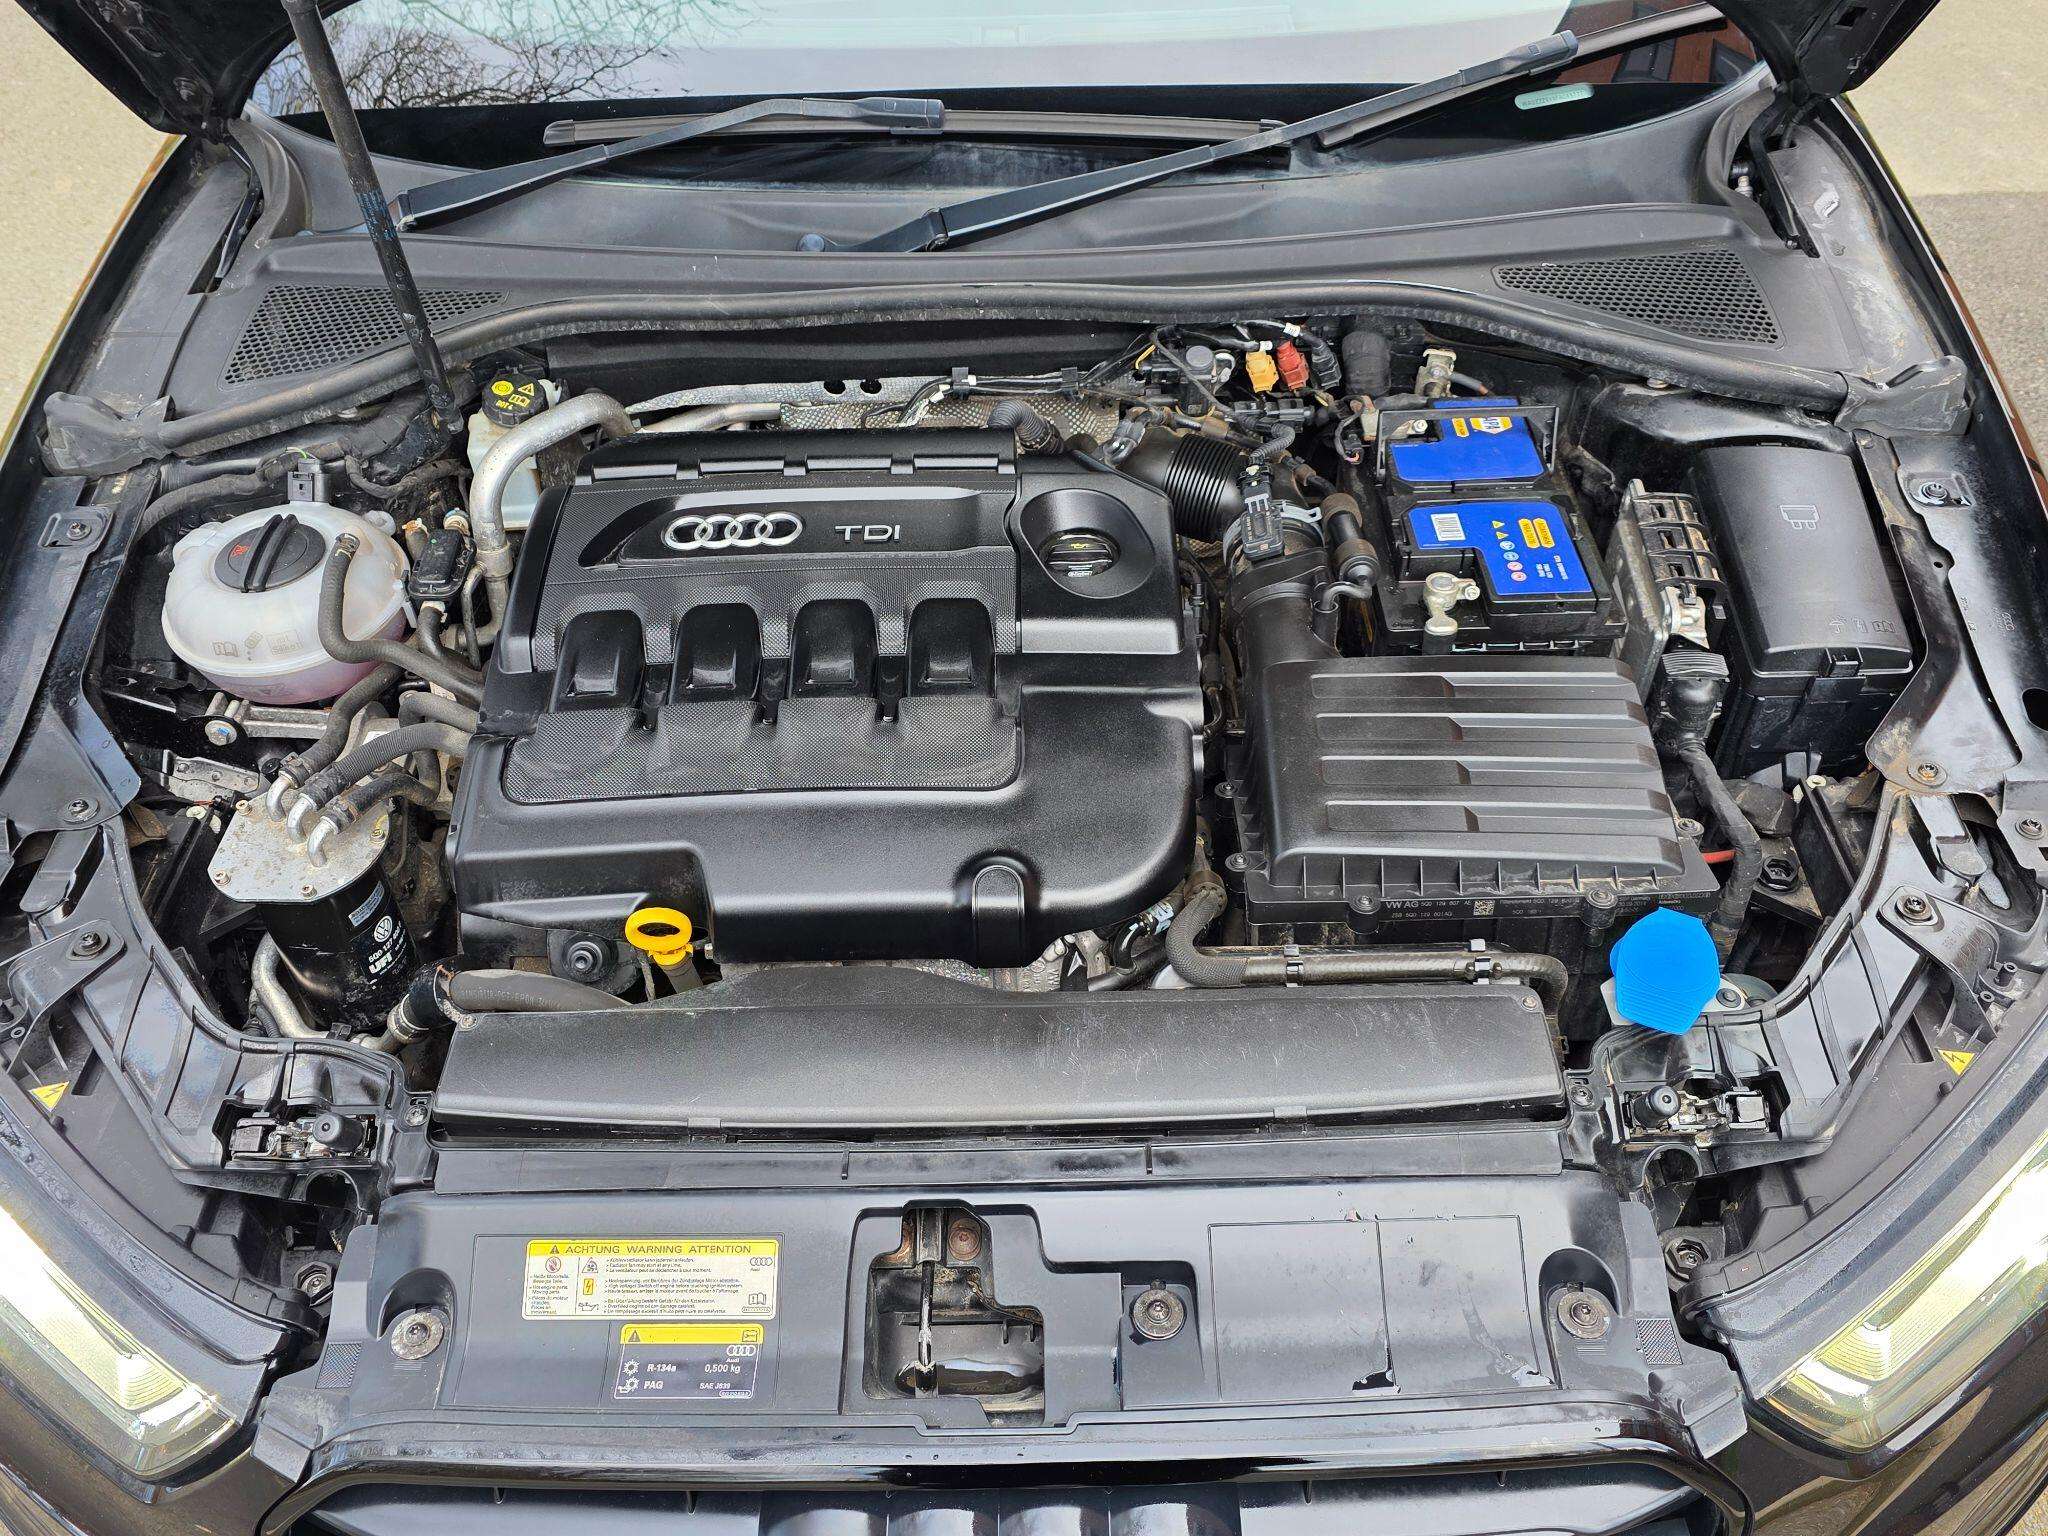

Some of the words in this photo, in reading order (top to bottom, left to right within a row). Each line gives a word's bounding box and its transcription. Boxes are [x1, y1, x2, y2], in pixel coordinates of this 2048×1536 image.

[496, 400, 510, 408] DOT
[835, 524, 901, 543] TDI
[566, 1245, 620, 1254] ACHTUNG
[626, 1245, 682, 1254] WARNING
[689, 1245, 752, 1253] ATTENTION
[646, 1364, 676, 1372] R-134a
[704, 1364, 729, 1373] 0,500
[730, 1364, 741, 1373] kg
[644, 1380, 663, 1389] PAG
